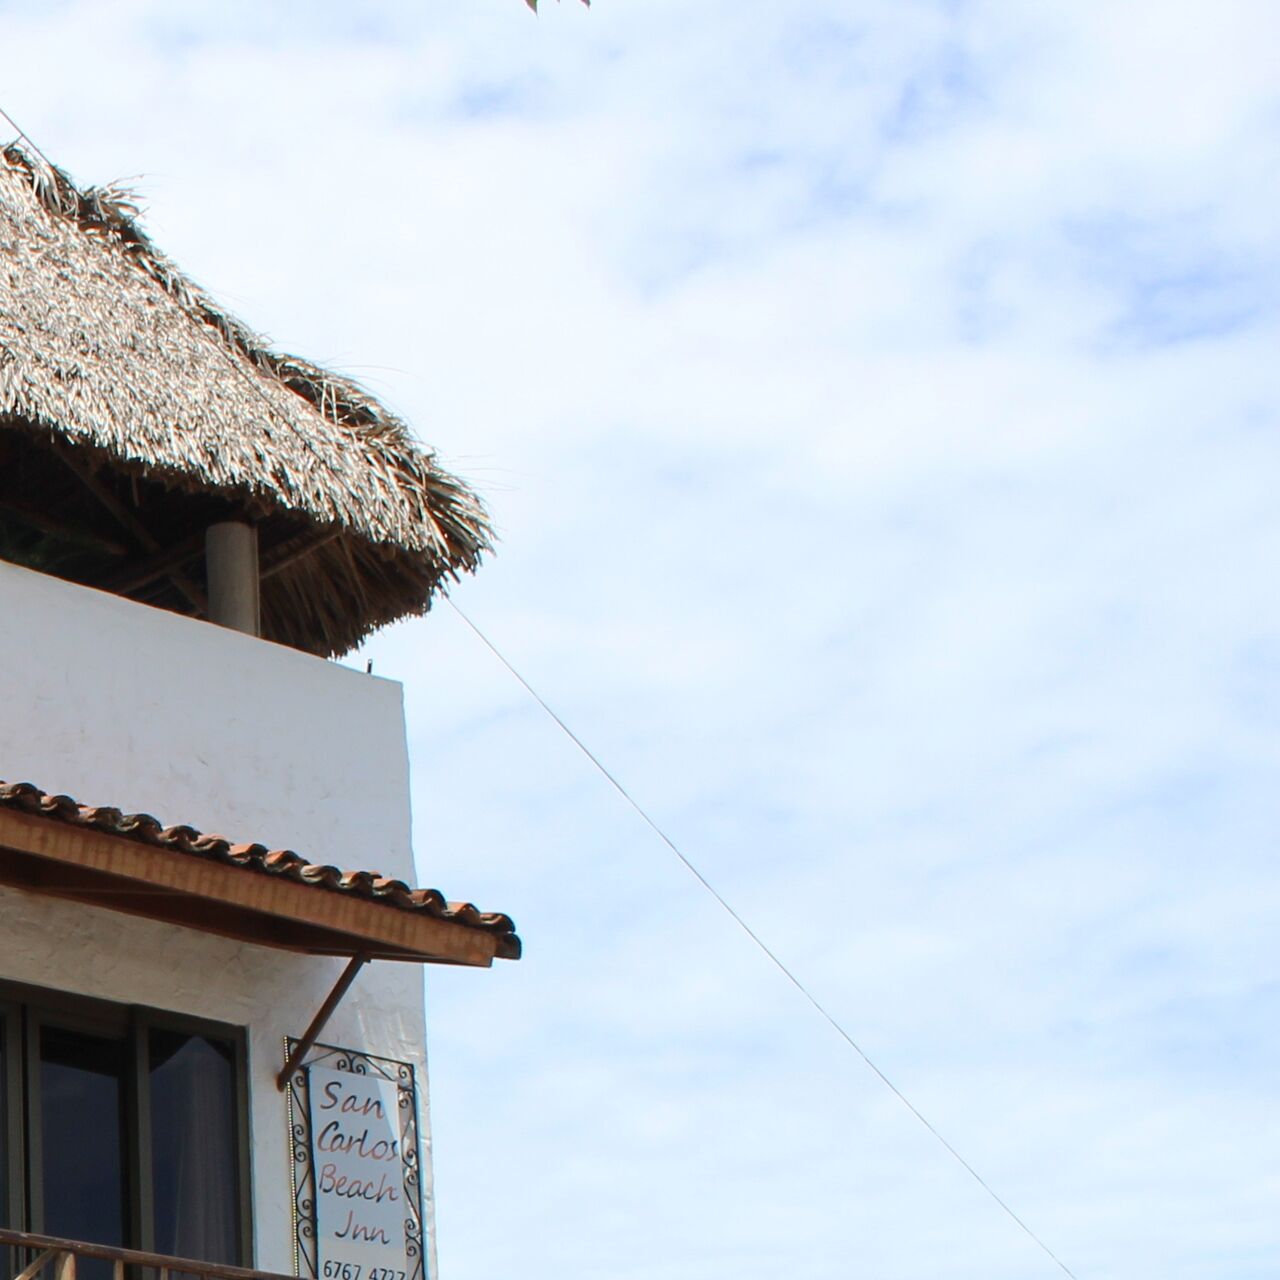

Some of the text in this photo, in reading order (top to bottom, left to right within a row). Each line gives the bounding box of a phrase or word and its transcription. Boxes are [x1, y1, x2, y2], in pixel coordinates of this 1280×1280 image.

[320, 1082, 383, 1119] San
[317, 1121, 399, 1161] Carlos
[319, 1164, 399, 1201] Beach
[335, 1211, 390, 1244] Inn
